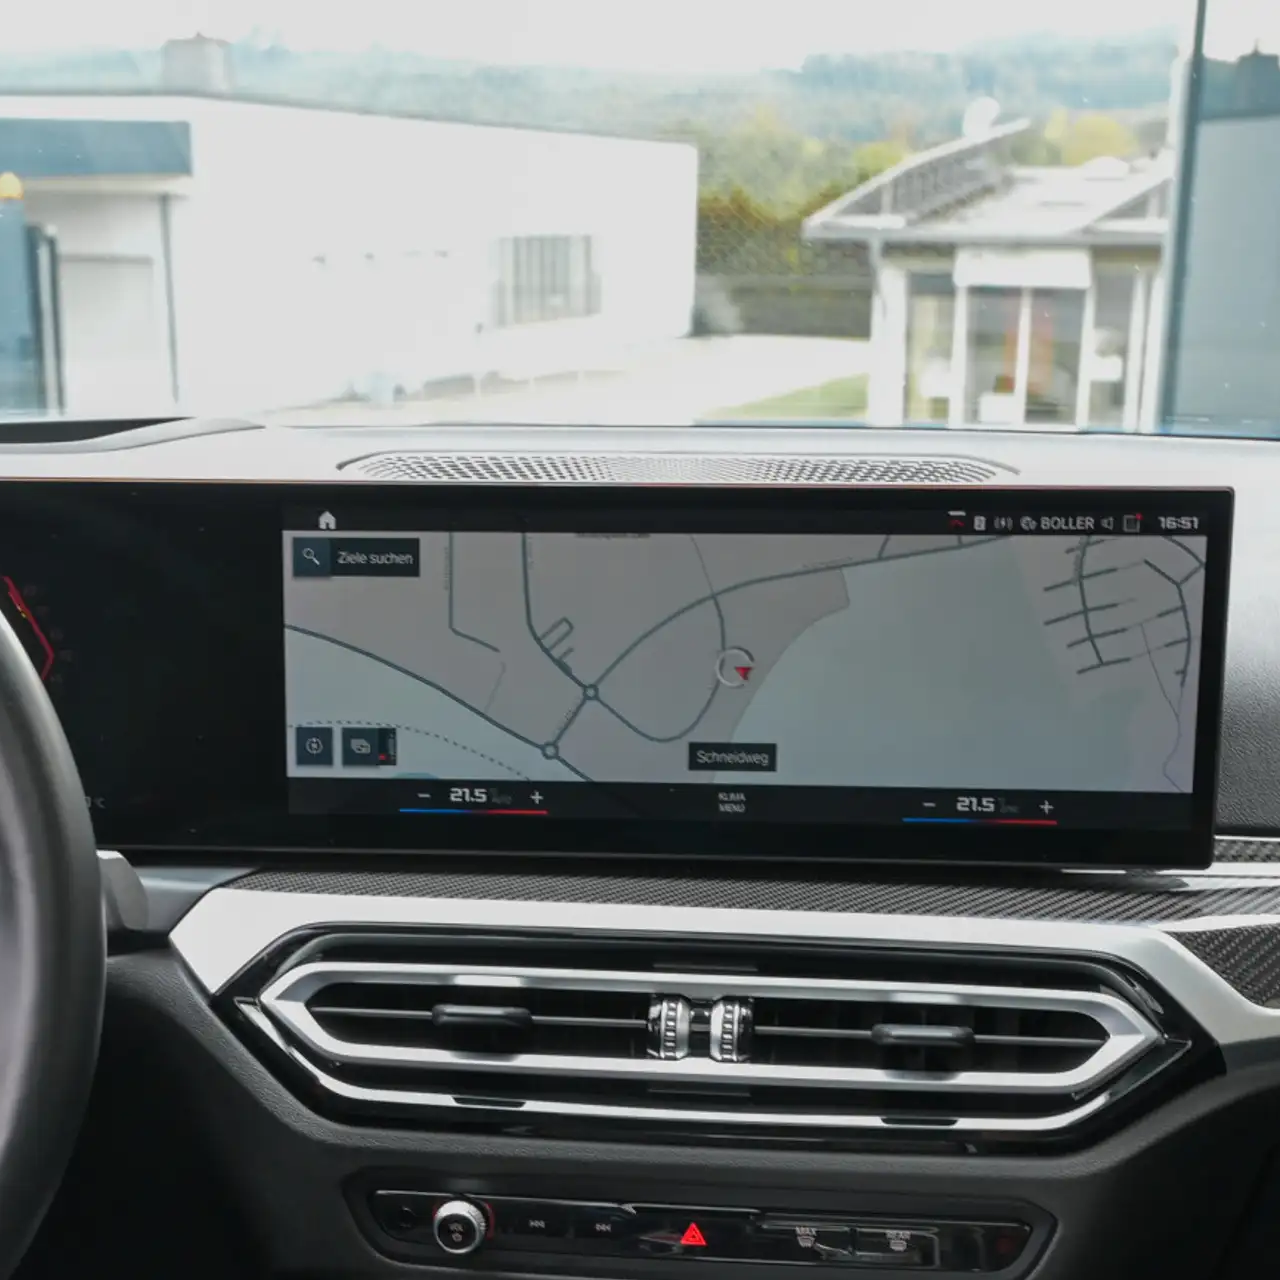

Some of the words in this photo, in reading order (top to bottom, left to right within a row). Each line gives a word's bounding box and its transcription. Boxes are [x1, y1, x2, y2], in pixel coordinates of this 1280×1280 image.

[1039, 516, 1095, 530] BOLLER
[1158, 516, 1199, 530] 16:51
[337, 550, 368, 564] Ziele
[370, 552, 414, 565] suchen
[696, 750, 770, 767] Schneidweg
[450, 788, 487, 803] 21.5
[956, 797, 995, 812] 21.5
